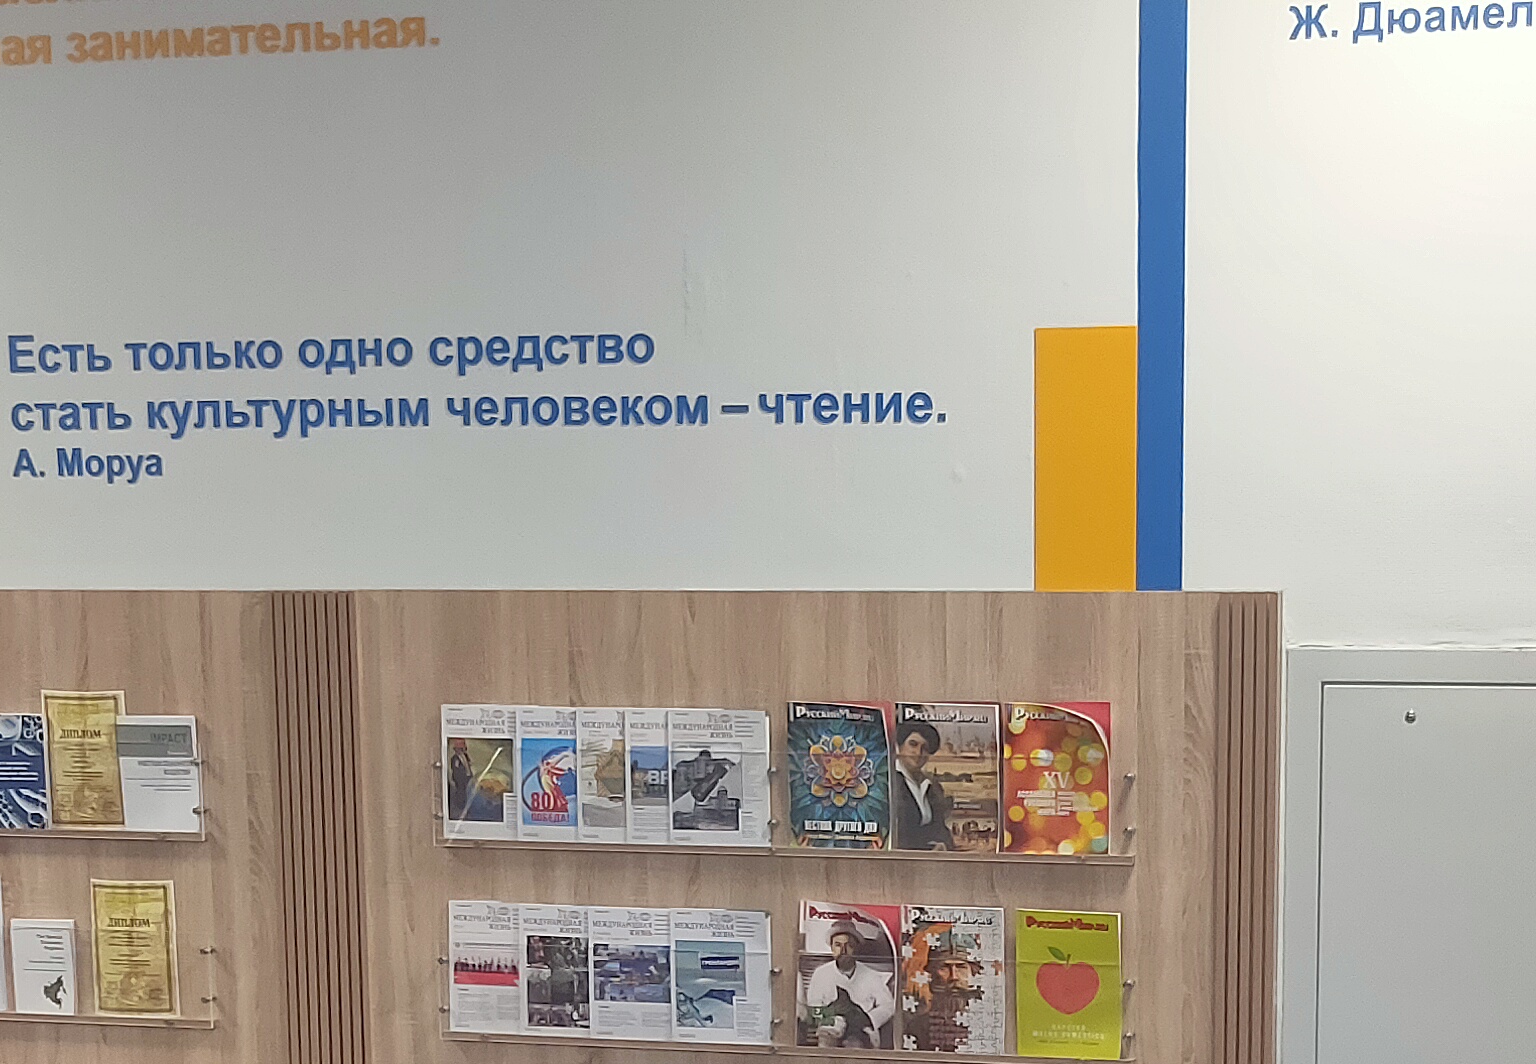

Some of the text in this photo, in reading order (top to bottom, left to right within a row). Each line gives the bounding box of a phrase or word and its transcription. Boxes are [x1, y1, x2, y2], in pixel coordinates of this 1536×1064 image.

[67, 16, 440, 64] занимательная.
[1289, 3, 1338, 40] Ж.
[8, 329, 654, 377] Есть только одно средство
[12, 398, 131, 432] стать
[146, 397, 429, 440] культурным
[446, 391, 709, 427] человеком
[13, 446, 164, 484] А. Моруа
[1043, 771, 1071, 789] XV
